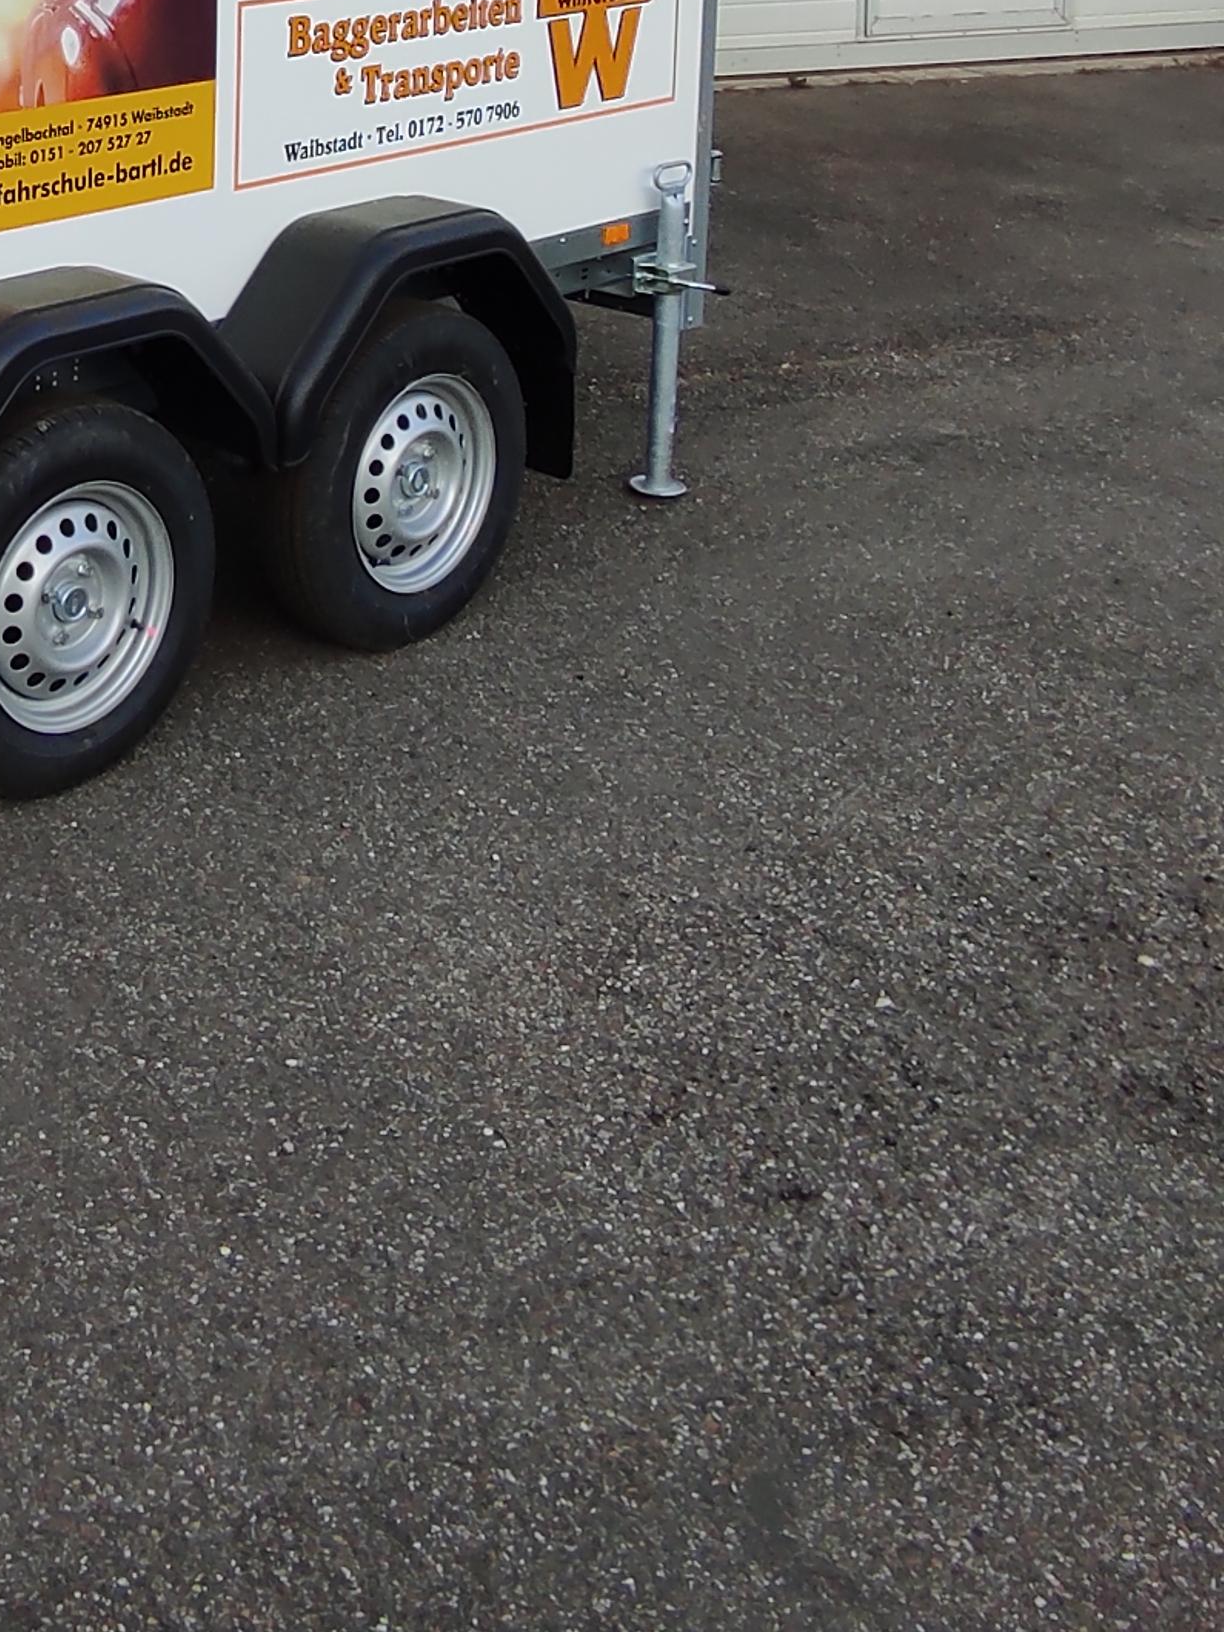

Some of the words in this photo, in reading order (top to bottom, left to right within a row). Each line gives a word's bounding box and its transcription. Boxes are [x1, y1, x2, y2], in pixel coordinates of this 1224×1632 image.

[334, 68, 352, 95] &
[361, 48, 521, 105] Transporte
[87, 111, 127, 132] 74915
[131, 103, 194, 125] Waibstadt
[284, 132, 364, 163] Waibstadt
[377, 124, 404, 146] Tel.
[407, 115, 444, 140] 0172
[455, 110, 483, 131] 570
[486, 101, 520, 126] 7906
[30, 146, 64, 164] 0151
[78, 139, 102, 156] 207
[107, 134, 131, 151] 527
[135, 130, 151, 145] 27
